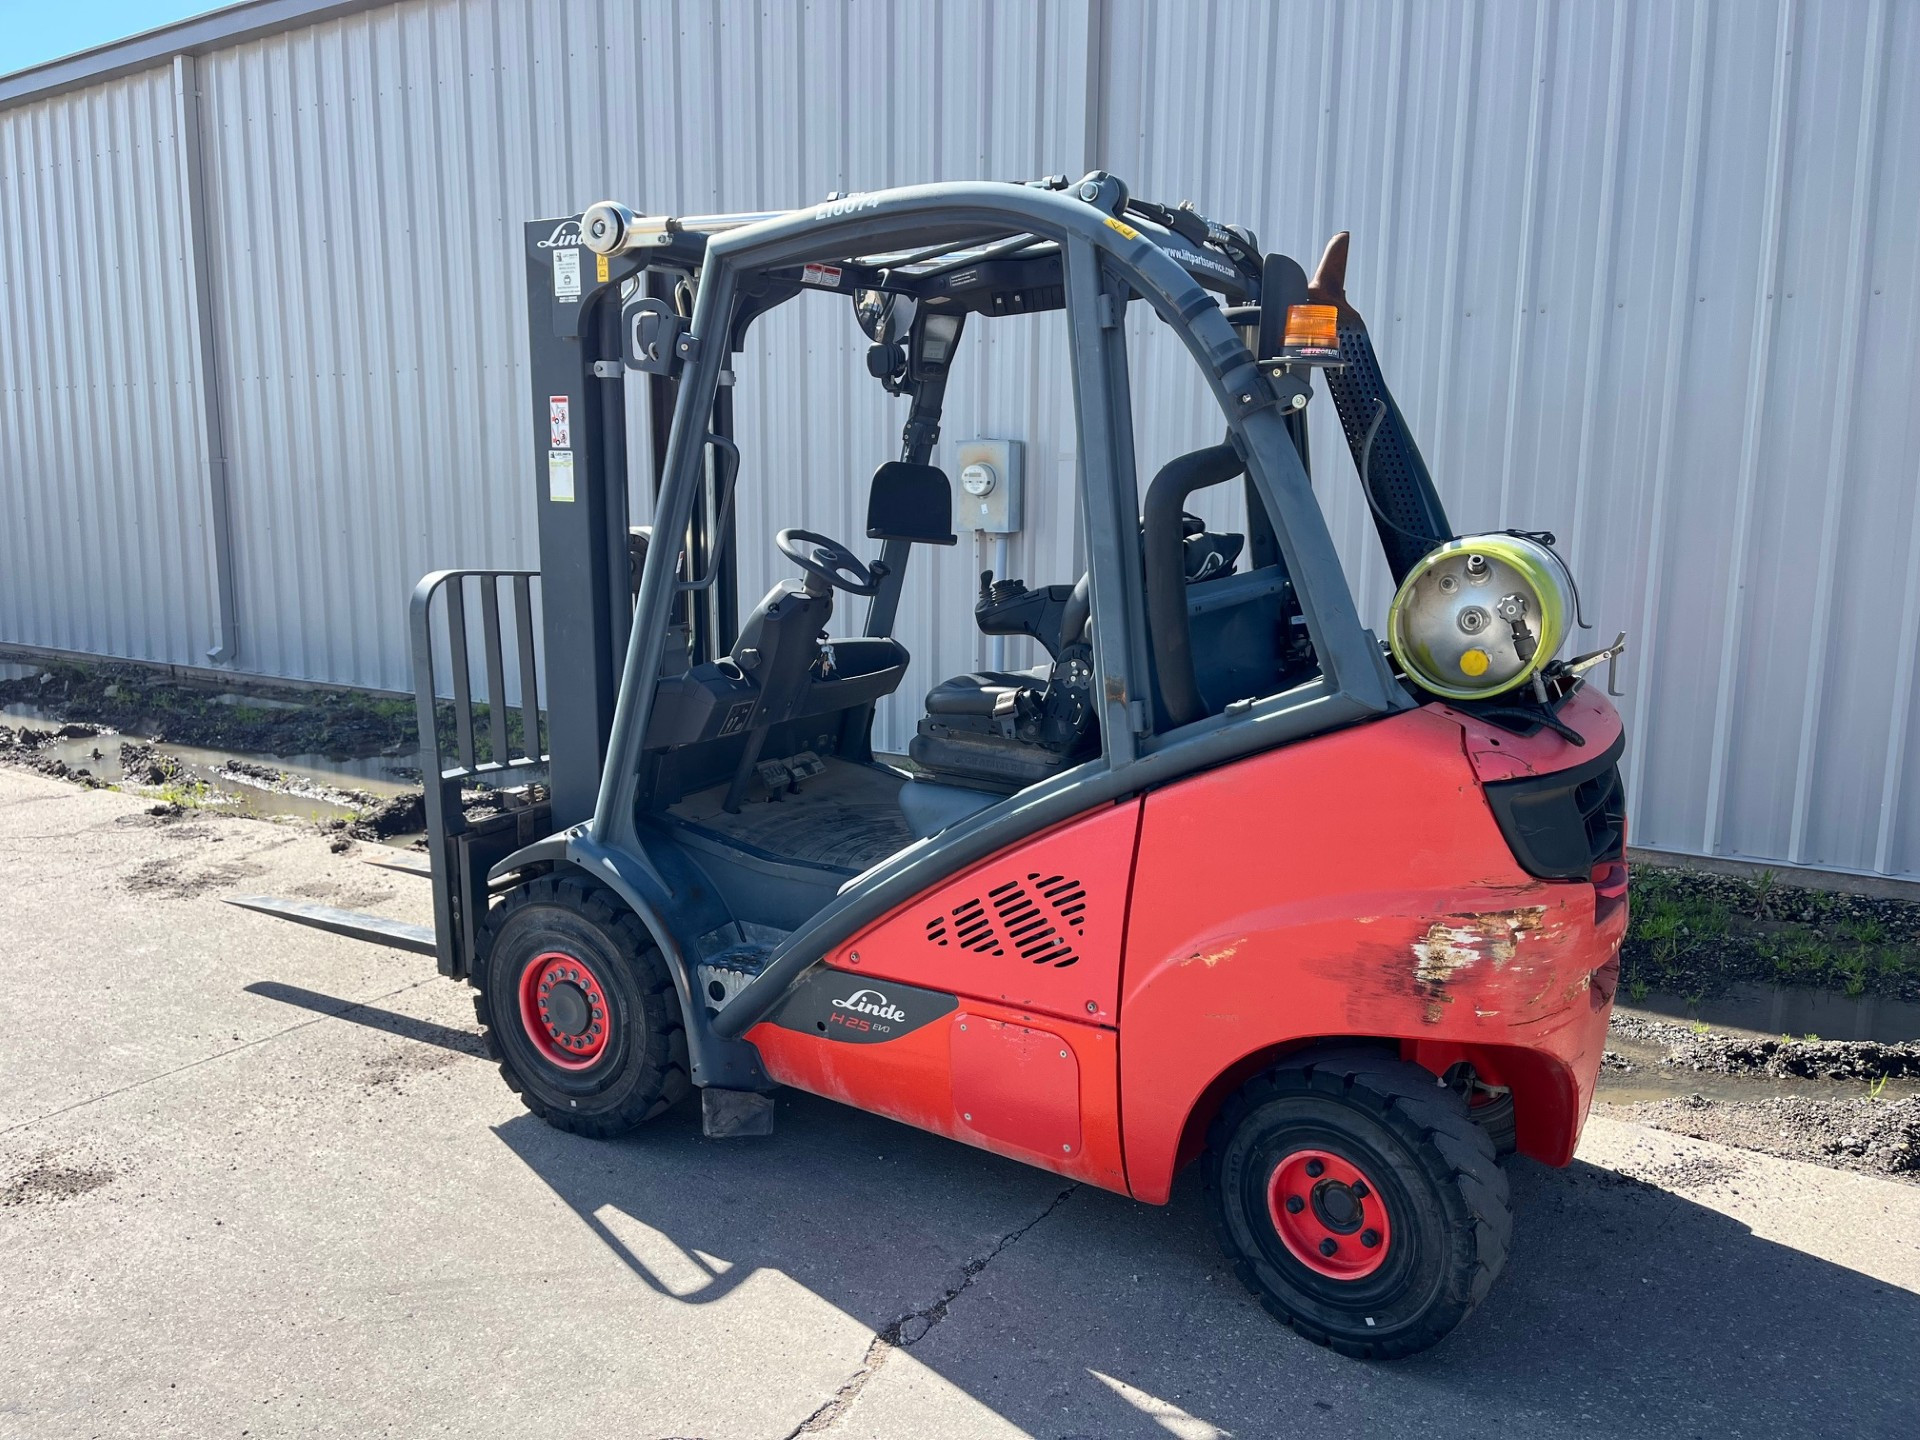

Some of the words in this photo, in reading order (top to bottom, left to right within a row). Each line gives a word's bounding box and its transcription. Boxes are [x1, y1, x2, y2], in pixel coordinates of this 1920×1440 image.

[537, 221, 583, 248] Lin
[832, 989, 906, 1022] Linde
[872, 1023, 890, 1033] EVO
